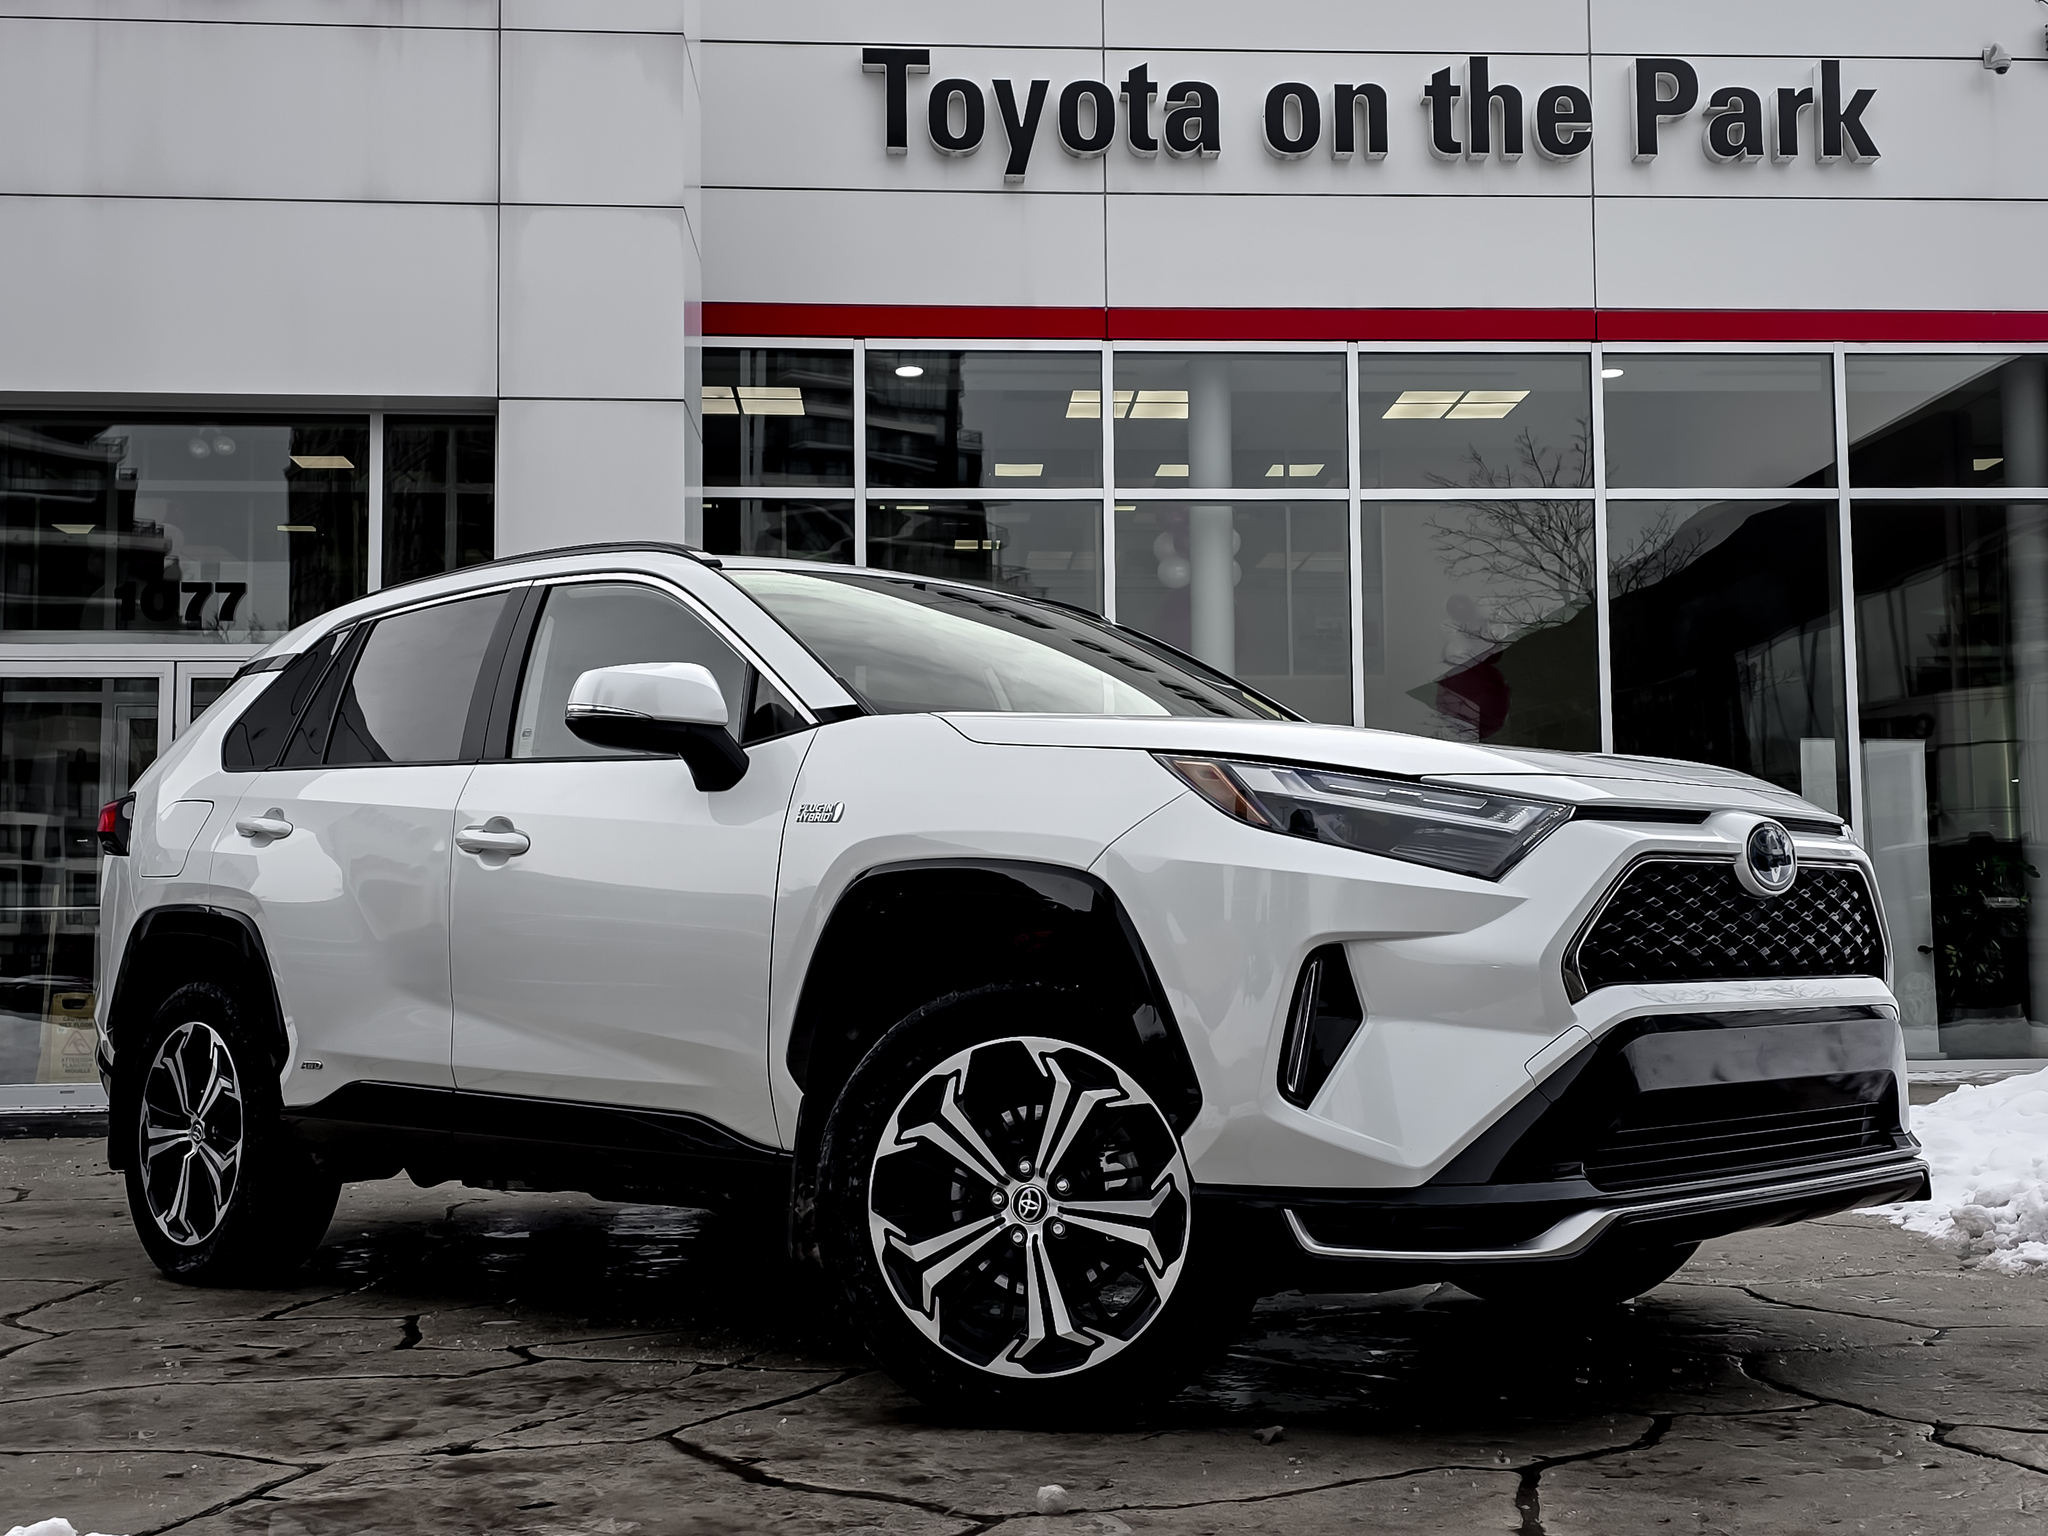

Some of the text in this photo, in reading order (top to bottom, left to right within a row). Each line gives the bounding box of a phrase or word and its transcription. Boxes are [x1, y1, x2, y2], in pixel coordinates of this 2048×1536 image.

[861, 47, 1881, 182] Toyota on the Park
[114, 581, 248, 622] 1077
[796, 812, 833, 823] HYBRID
